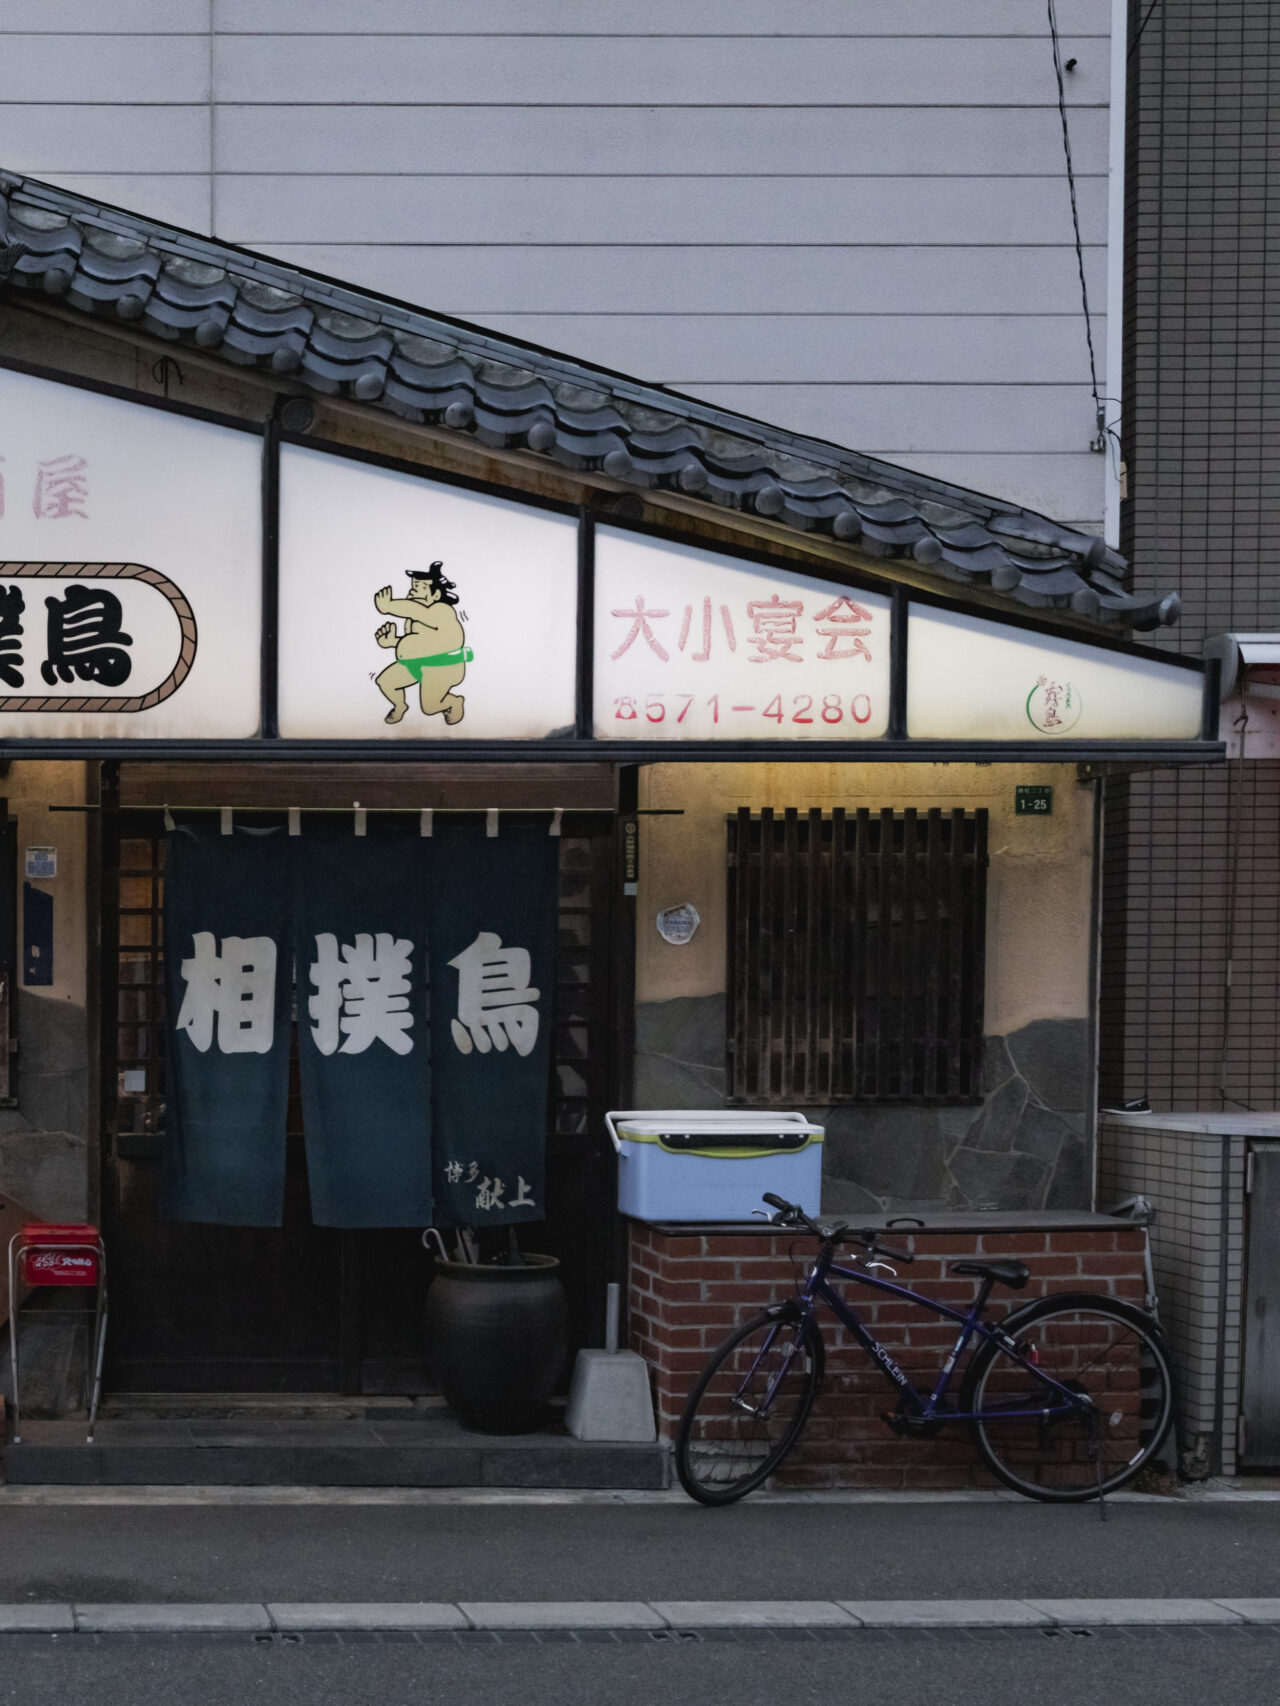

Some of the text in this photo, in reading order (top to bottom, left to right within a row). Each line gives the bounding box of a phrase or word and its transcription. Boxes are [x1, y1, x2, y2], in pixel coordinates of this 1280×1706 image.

[610, 594, 874, 663] 大小宴会
[1020, 799, 1047, 810] 1-25
[175, 930, 541, 1057] 相撲鳥
[443, 1160, 480, 1183] 博多
[475, 1175, 536, 1211] 献上
